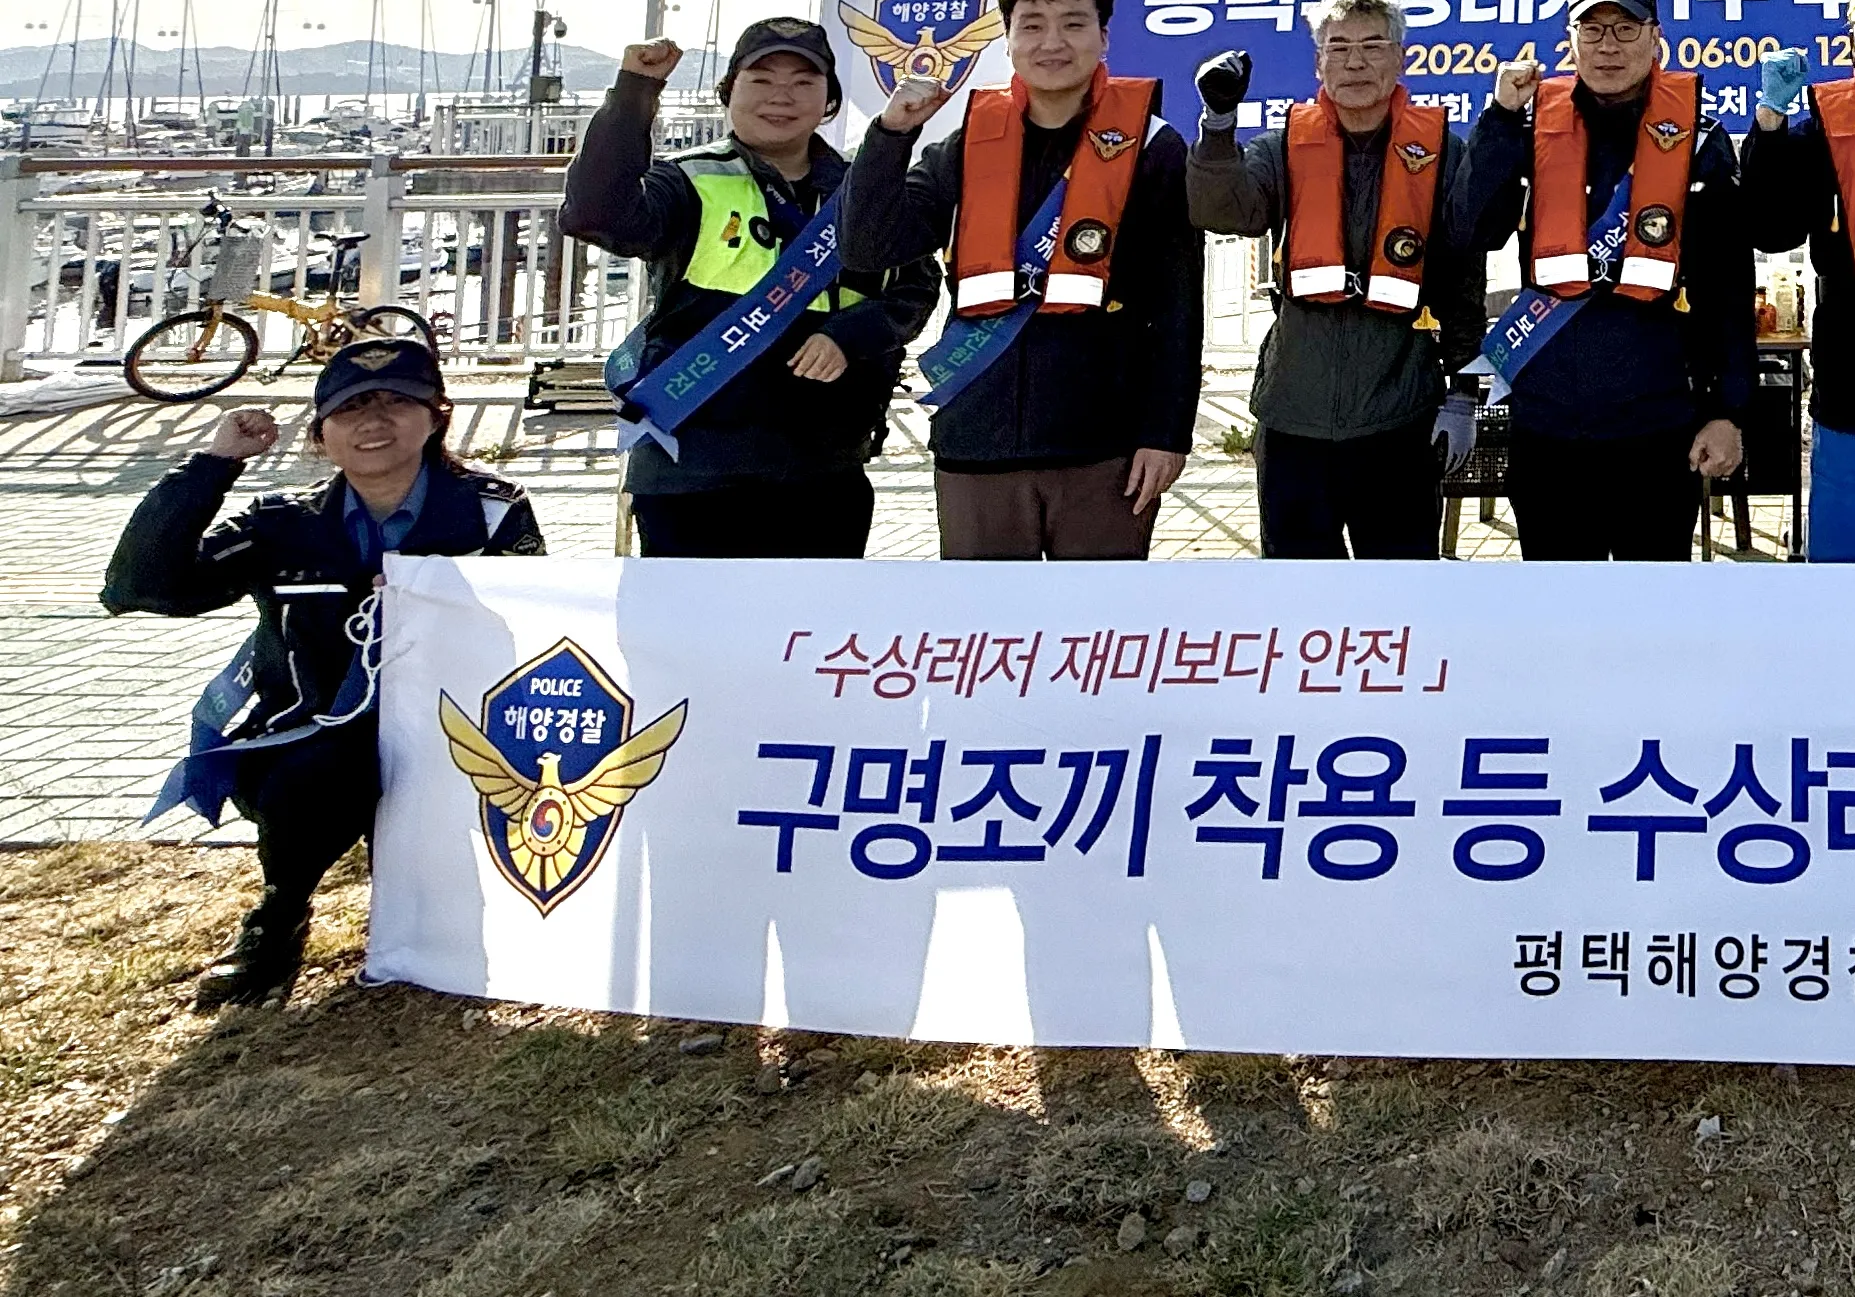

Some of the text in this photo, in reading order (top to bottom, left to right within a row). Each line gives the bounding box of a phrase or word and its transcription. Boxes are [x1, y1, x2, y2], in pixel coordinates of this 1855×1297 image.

[892, 0, 968, 23] 해양경찰
[664, 353, 721, 400] 안전
[1049, 626, 1284, 696] 재미보다
[529, 676, 582, 699] POLICE
[503, 706, 607, 745] 해양경찰
[737, 733, 1163, 879] 구명조끼
[1184, 734, 1416, 881] 착용
[1442, 737, 1562, 882] 등
